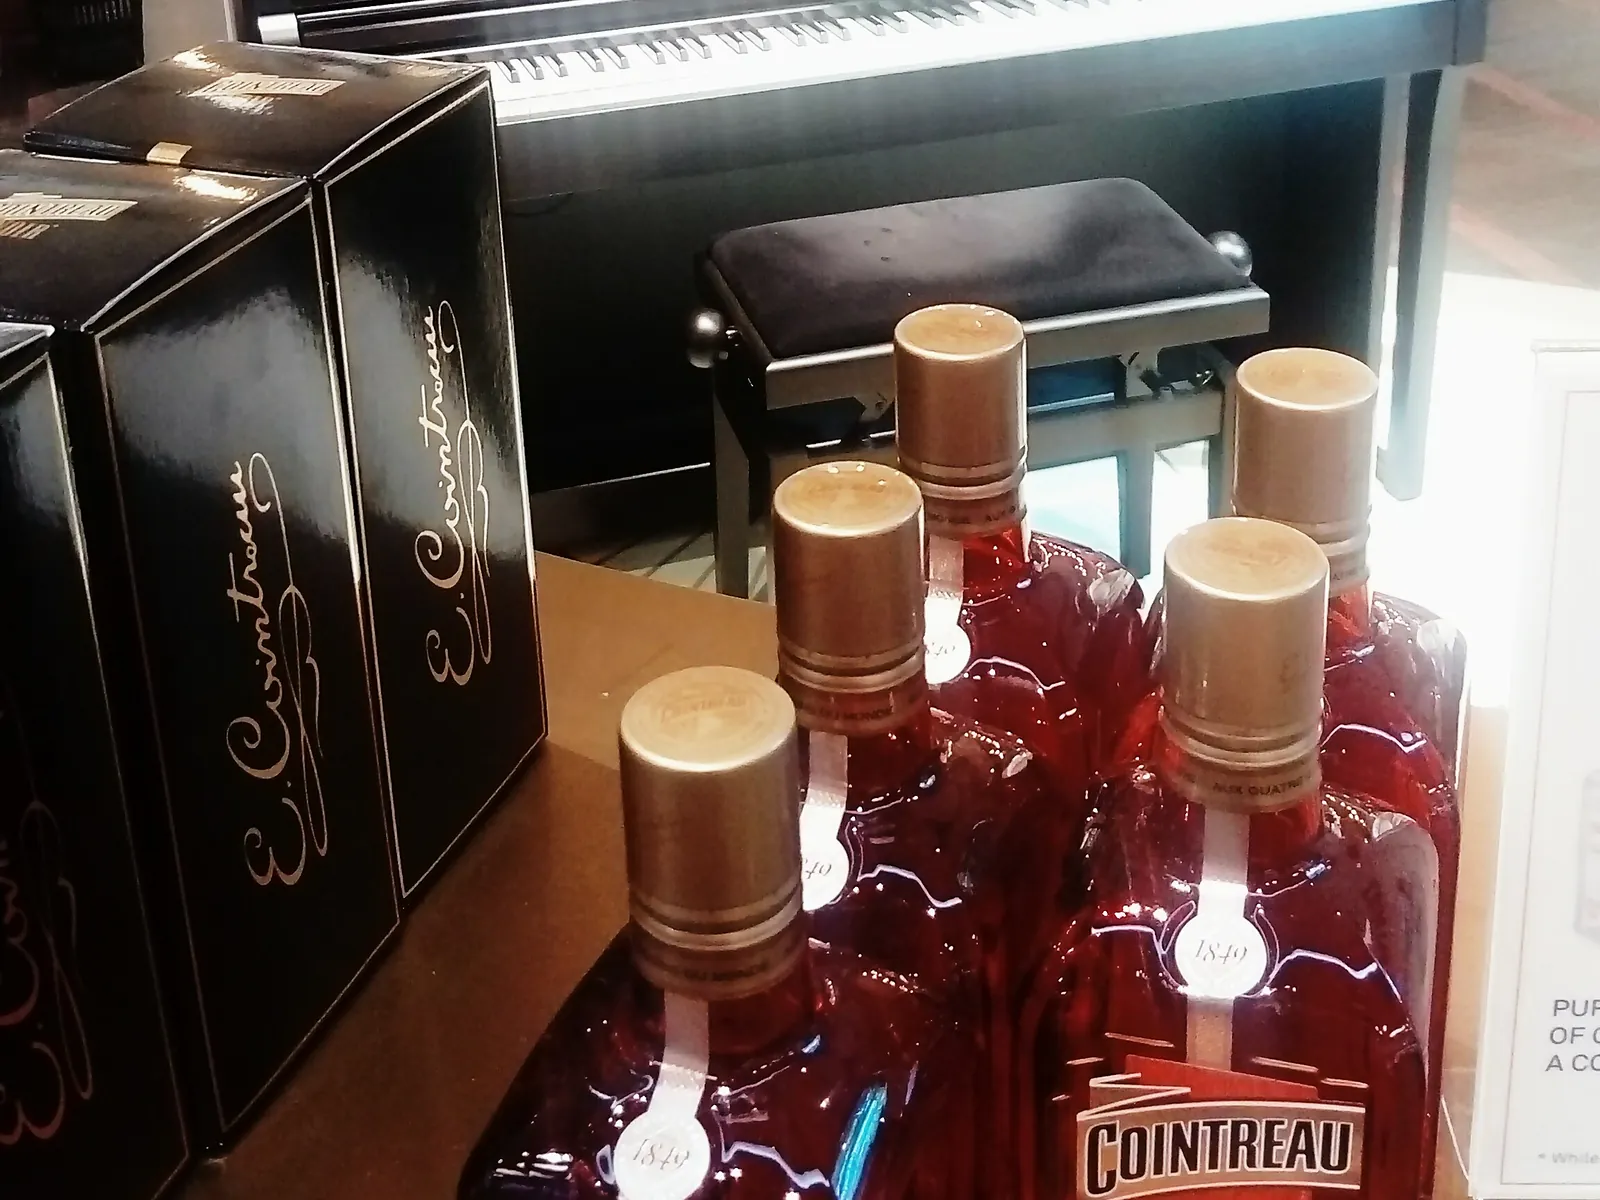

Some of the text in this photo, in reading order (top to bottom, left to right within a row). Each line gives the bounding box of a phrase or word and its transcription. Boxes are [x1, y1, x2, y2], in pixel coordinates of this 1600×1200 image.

[1550, 1026, 1586, 1044] OF
[1545, 1053, 1564, 1072] A
[1086, 1118, 1354, 1198] COINTREAU
